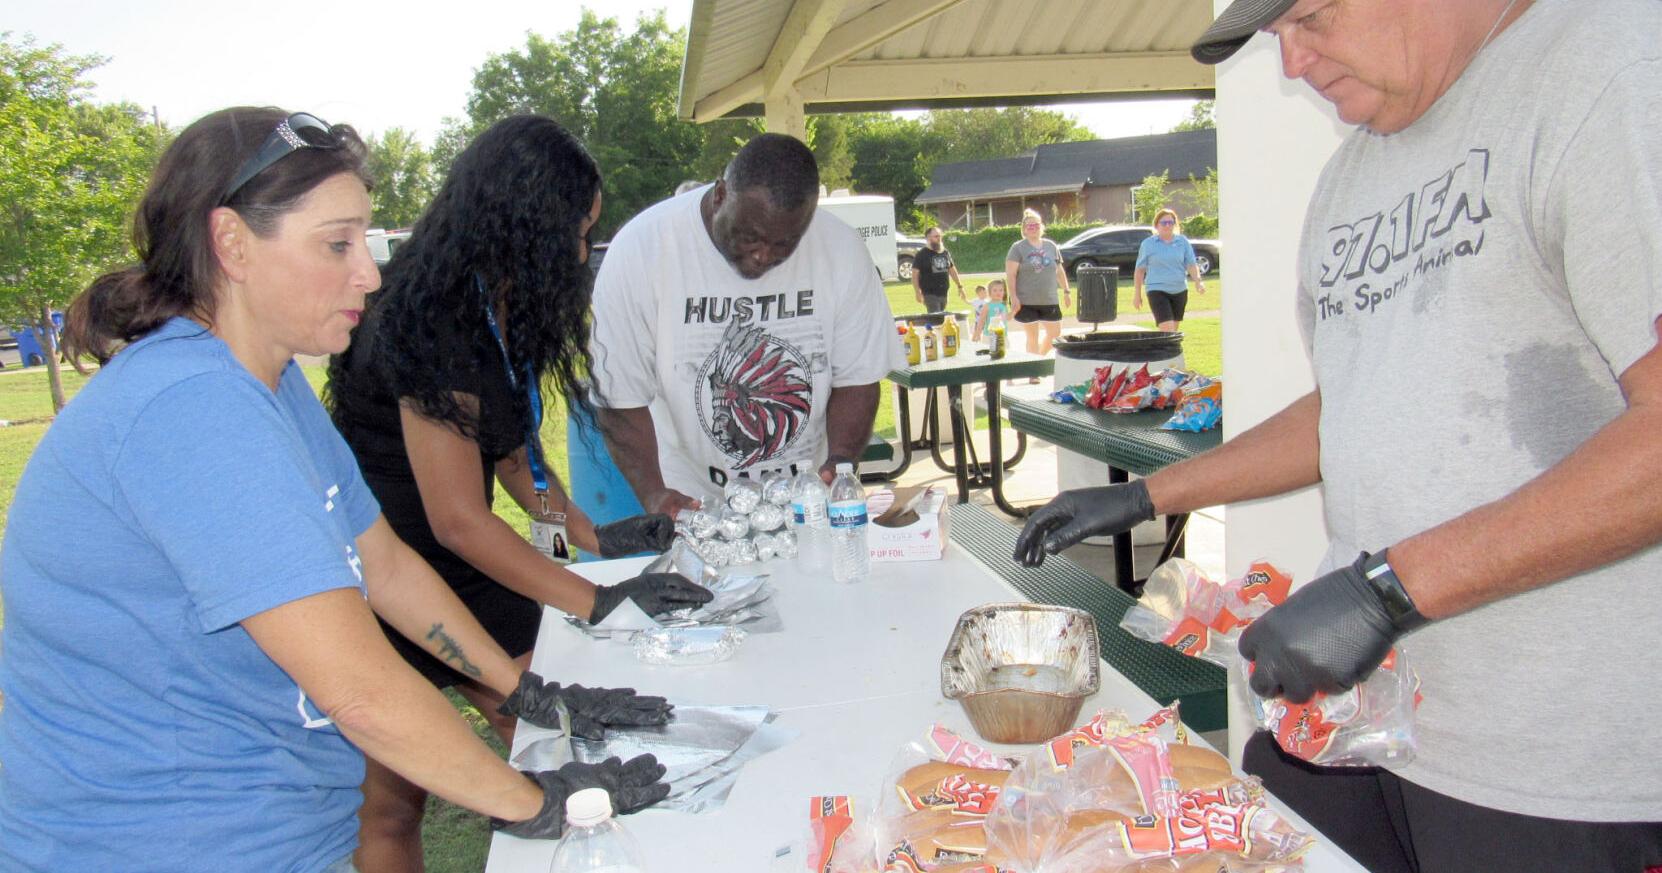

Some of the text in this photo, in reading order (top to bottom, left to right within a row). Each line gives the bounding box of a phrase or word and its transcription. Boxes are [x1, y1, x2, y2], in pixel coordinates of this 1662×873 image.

[871, 225, 888, 238] POLICE
[684, 289, 814, 325] HUSTLE
[1318, 293, 1344, 320] The
[877, 549, 888, 558] UP
[889, 549, 904, 558] FOIL
